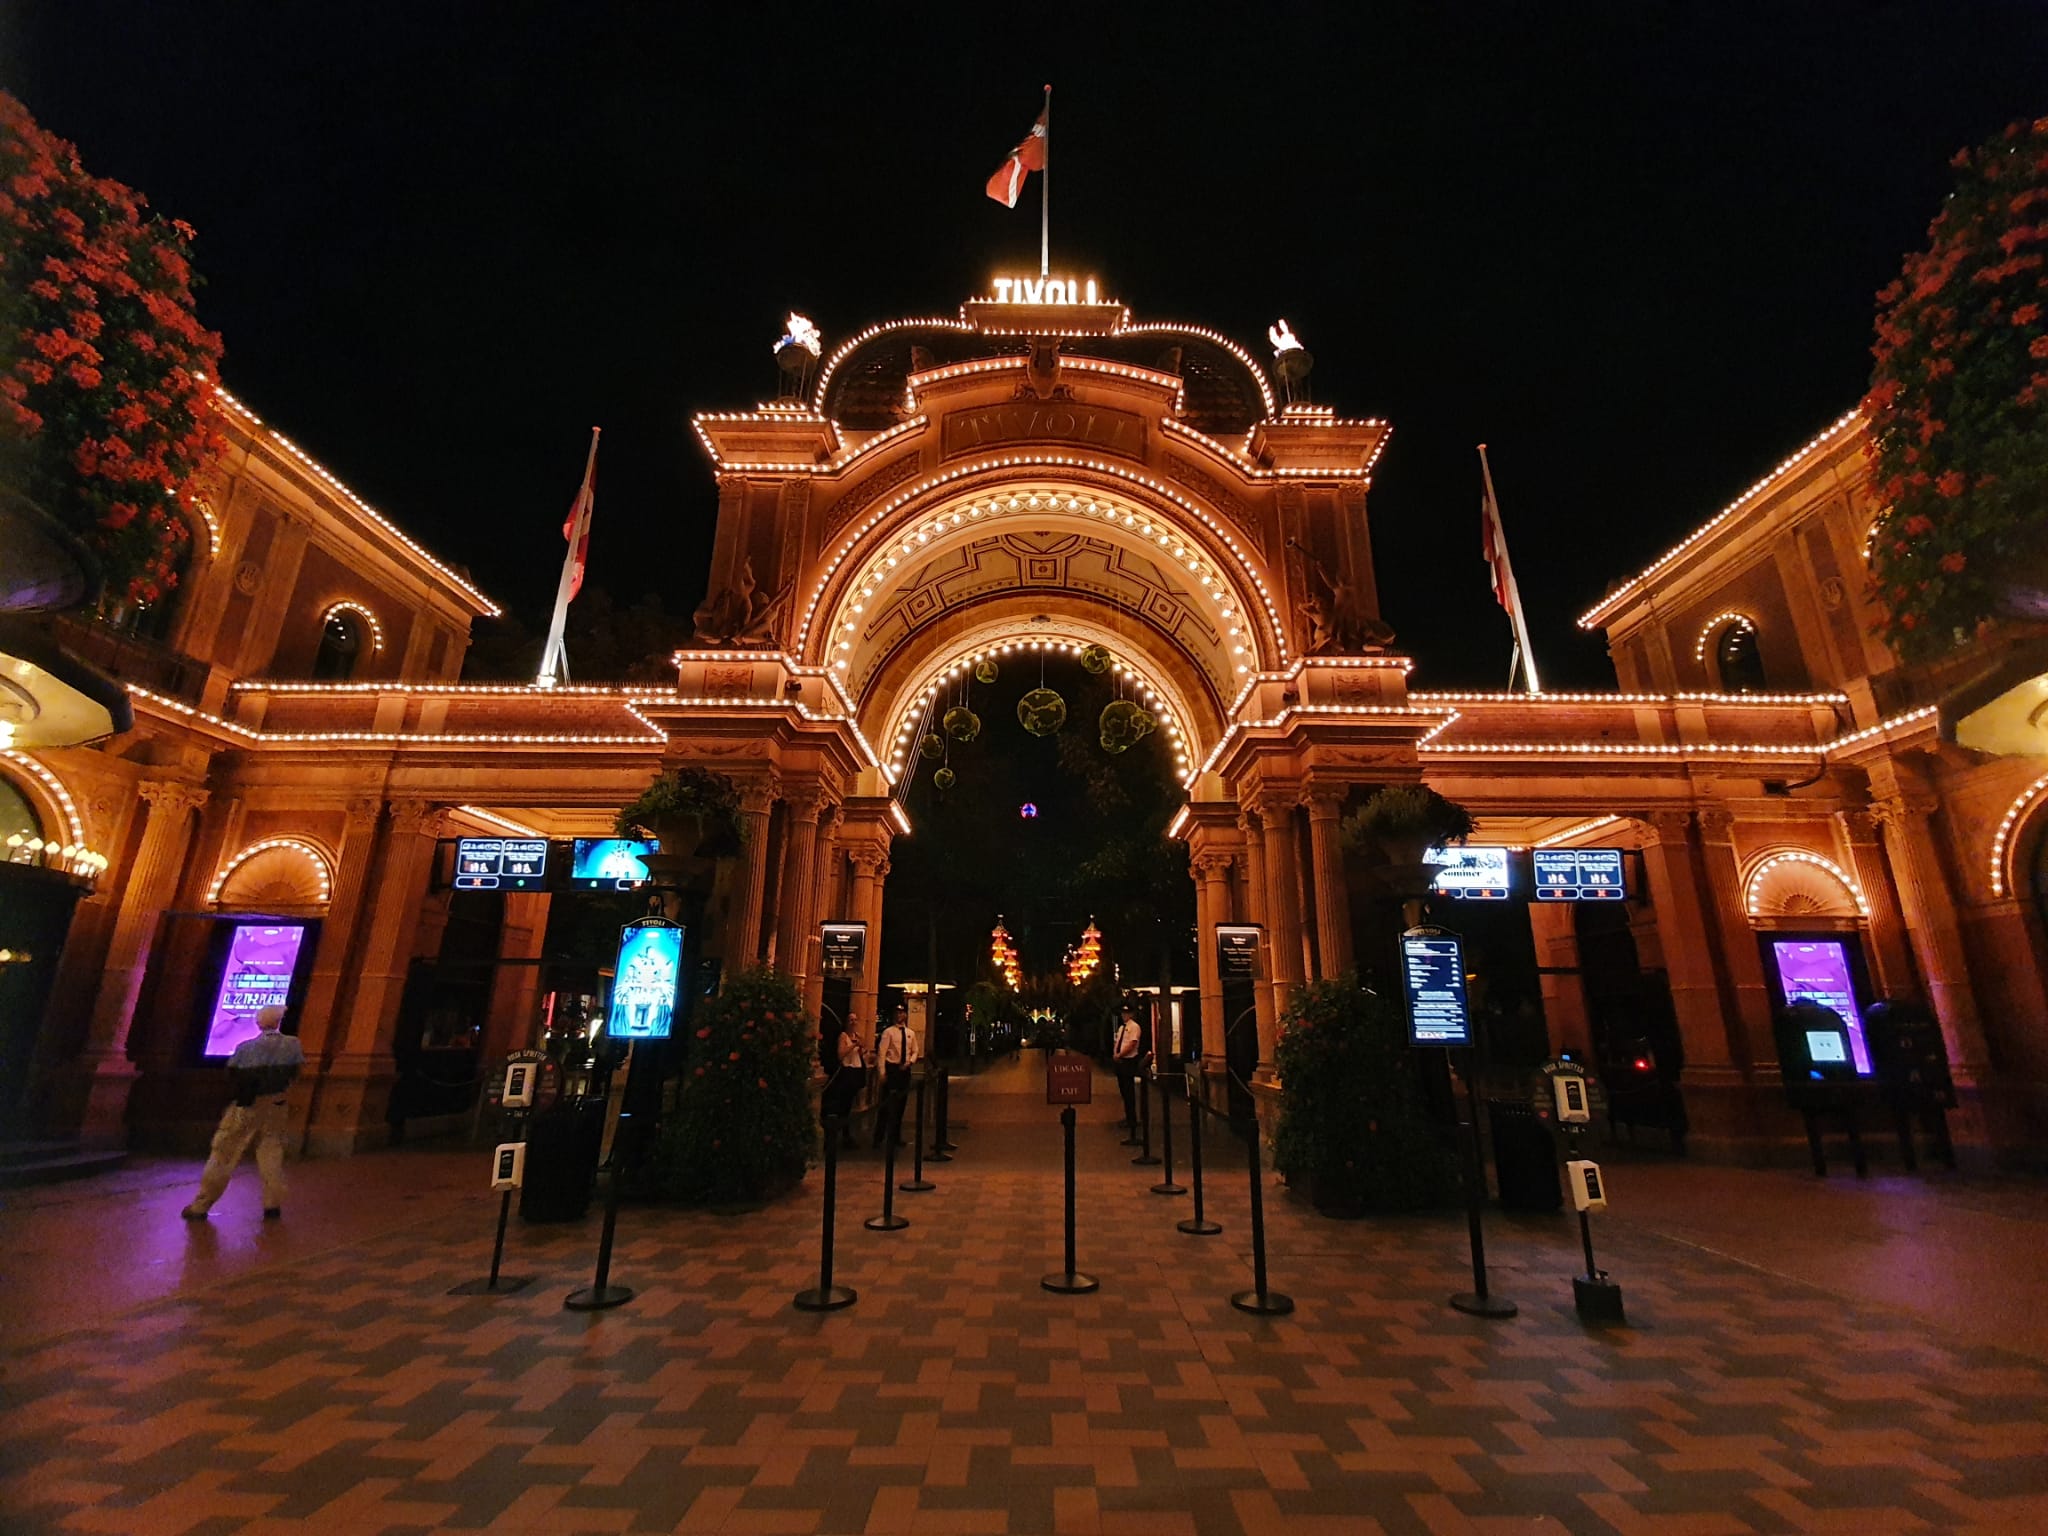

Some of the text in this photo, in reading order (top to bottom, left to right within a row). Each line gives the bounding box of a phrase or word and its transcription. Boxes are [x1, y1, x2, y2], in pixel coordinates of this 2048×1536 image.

[993, 278, 1097, 305] TIVOLI
[959, 409, 1126, 446] TIVOLI
[1061, 1088, 1078, 1096] EXIT
